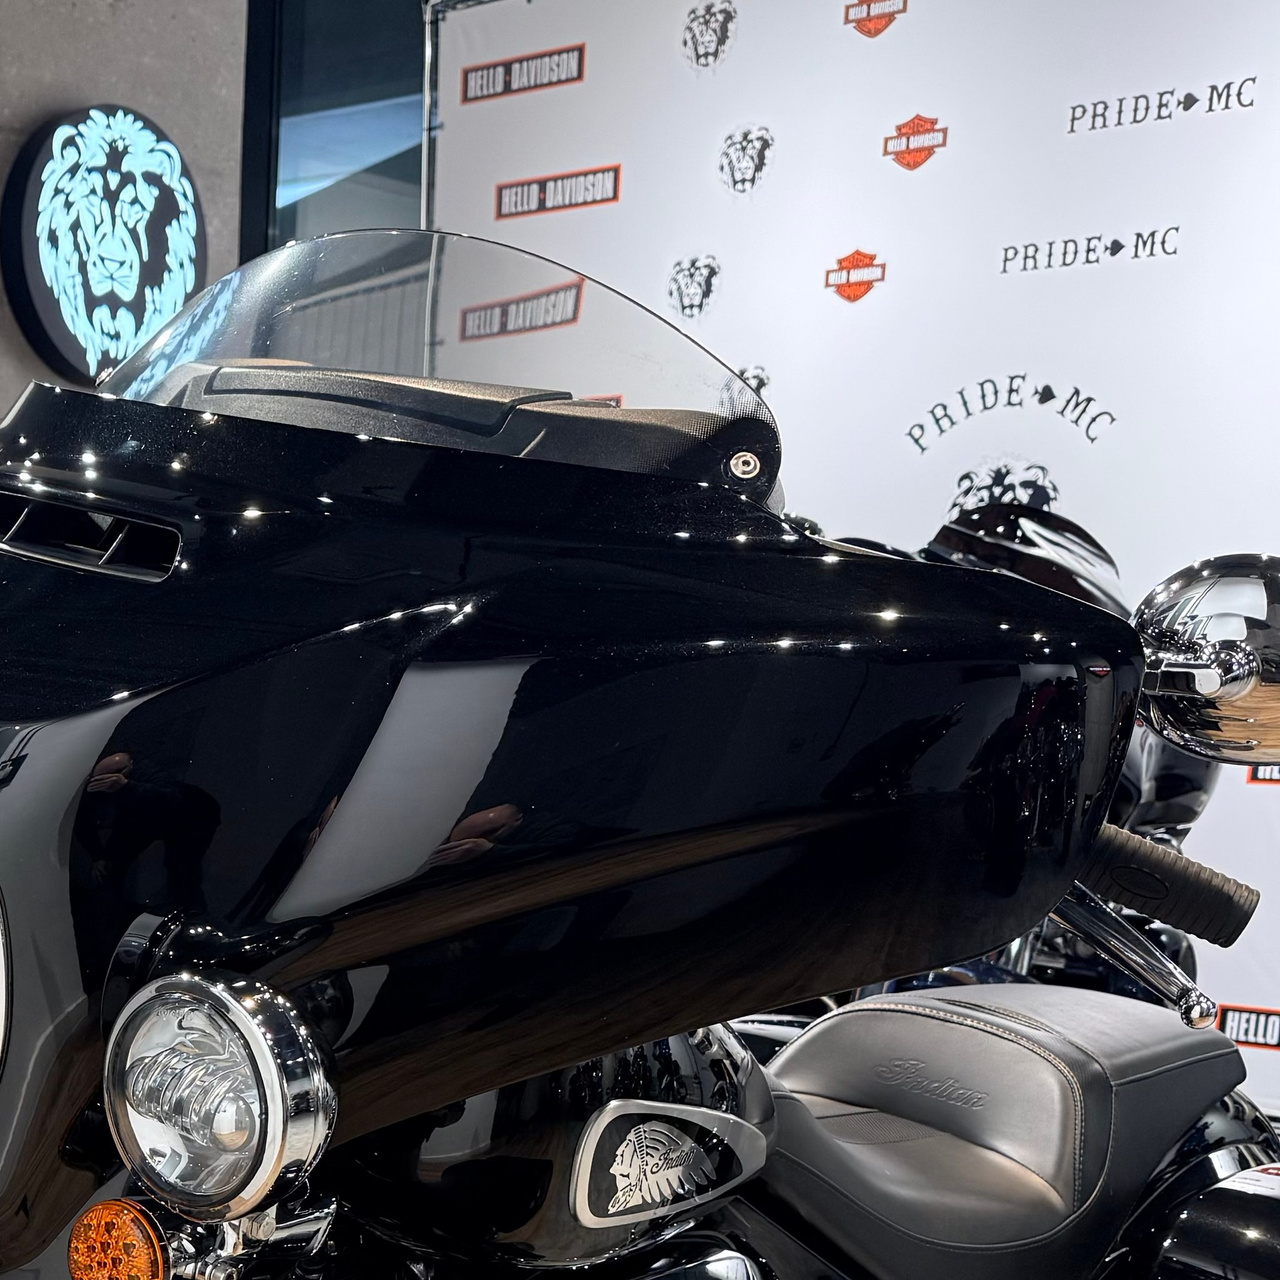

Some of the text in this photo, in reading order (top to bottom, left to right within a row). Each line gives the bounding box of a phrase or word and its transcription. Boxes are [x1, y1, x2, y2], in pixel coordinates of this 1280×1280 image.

[466, 49, 580, 100] HELLO DAVIDSON
[1066, 75, 1258, 135] PRIDE MC
[500, 170, 616, 218] HELLO DAVIDSON
[999, 225, 1180, 274] PRIDE MC
[904, 371, 1117, 456] PRIDE MC
[1225, 1010, 1280, 1046] HELLO
[872, 1057, 989, 1110] Indian
[650, 1146, 697, 1175] Indian
